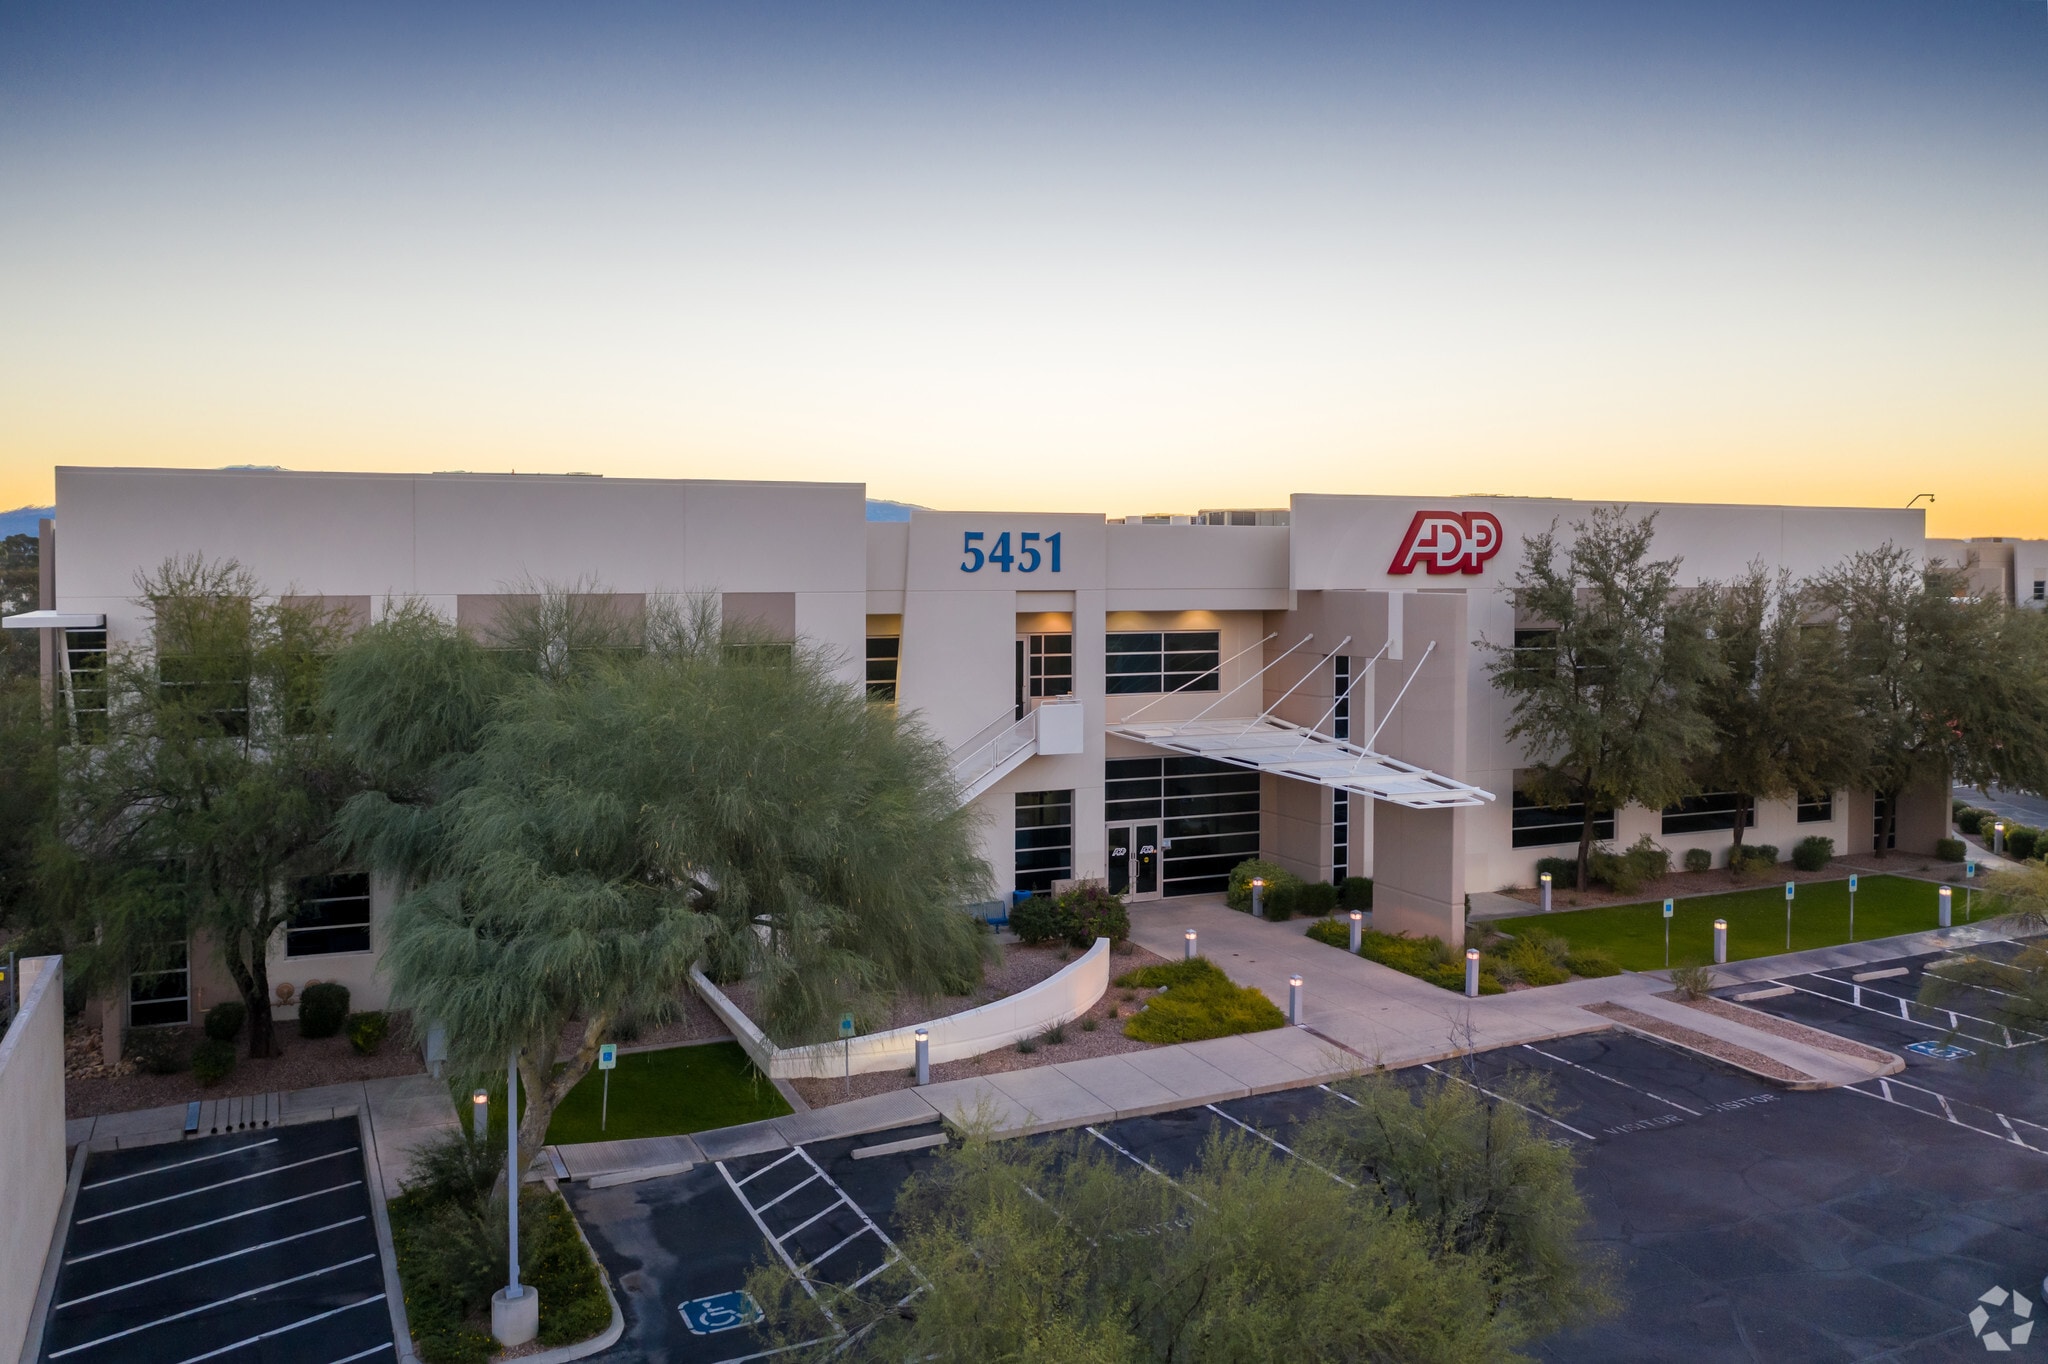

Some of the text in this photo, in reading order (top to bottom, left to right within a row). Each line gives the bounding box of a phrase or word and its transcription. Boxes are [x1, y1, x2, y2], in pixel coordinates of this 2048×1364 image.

[960, 531, 1061, 573] 5451
[1387, 510, 1503, 574] ADP
[1704, 1094, 1780, 1112] VISITOR
[1603, 1114, 1683, 1134] VISITOR
